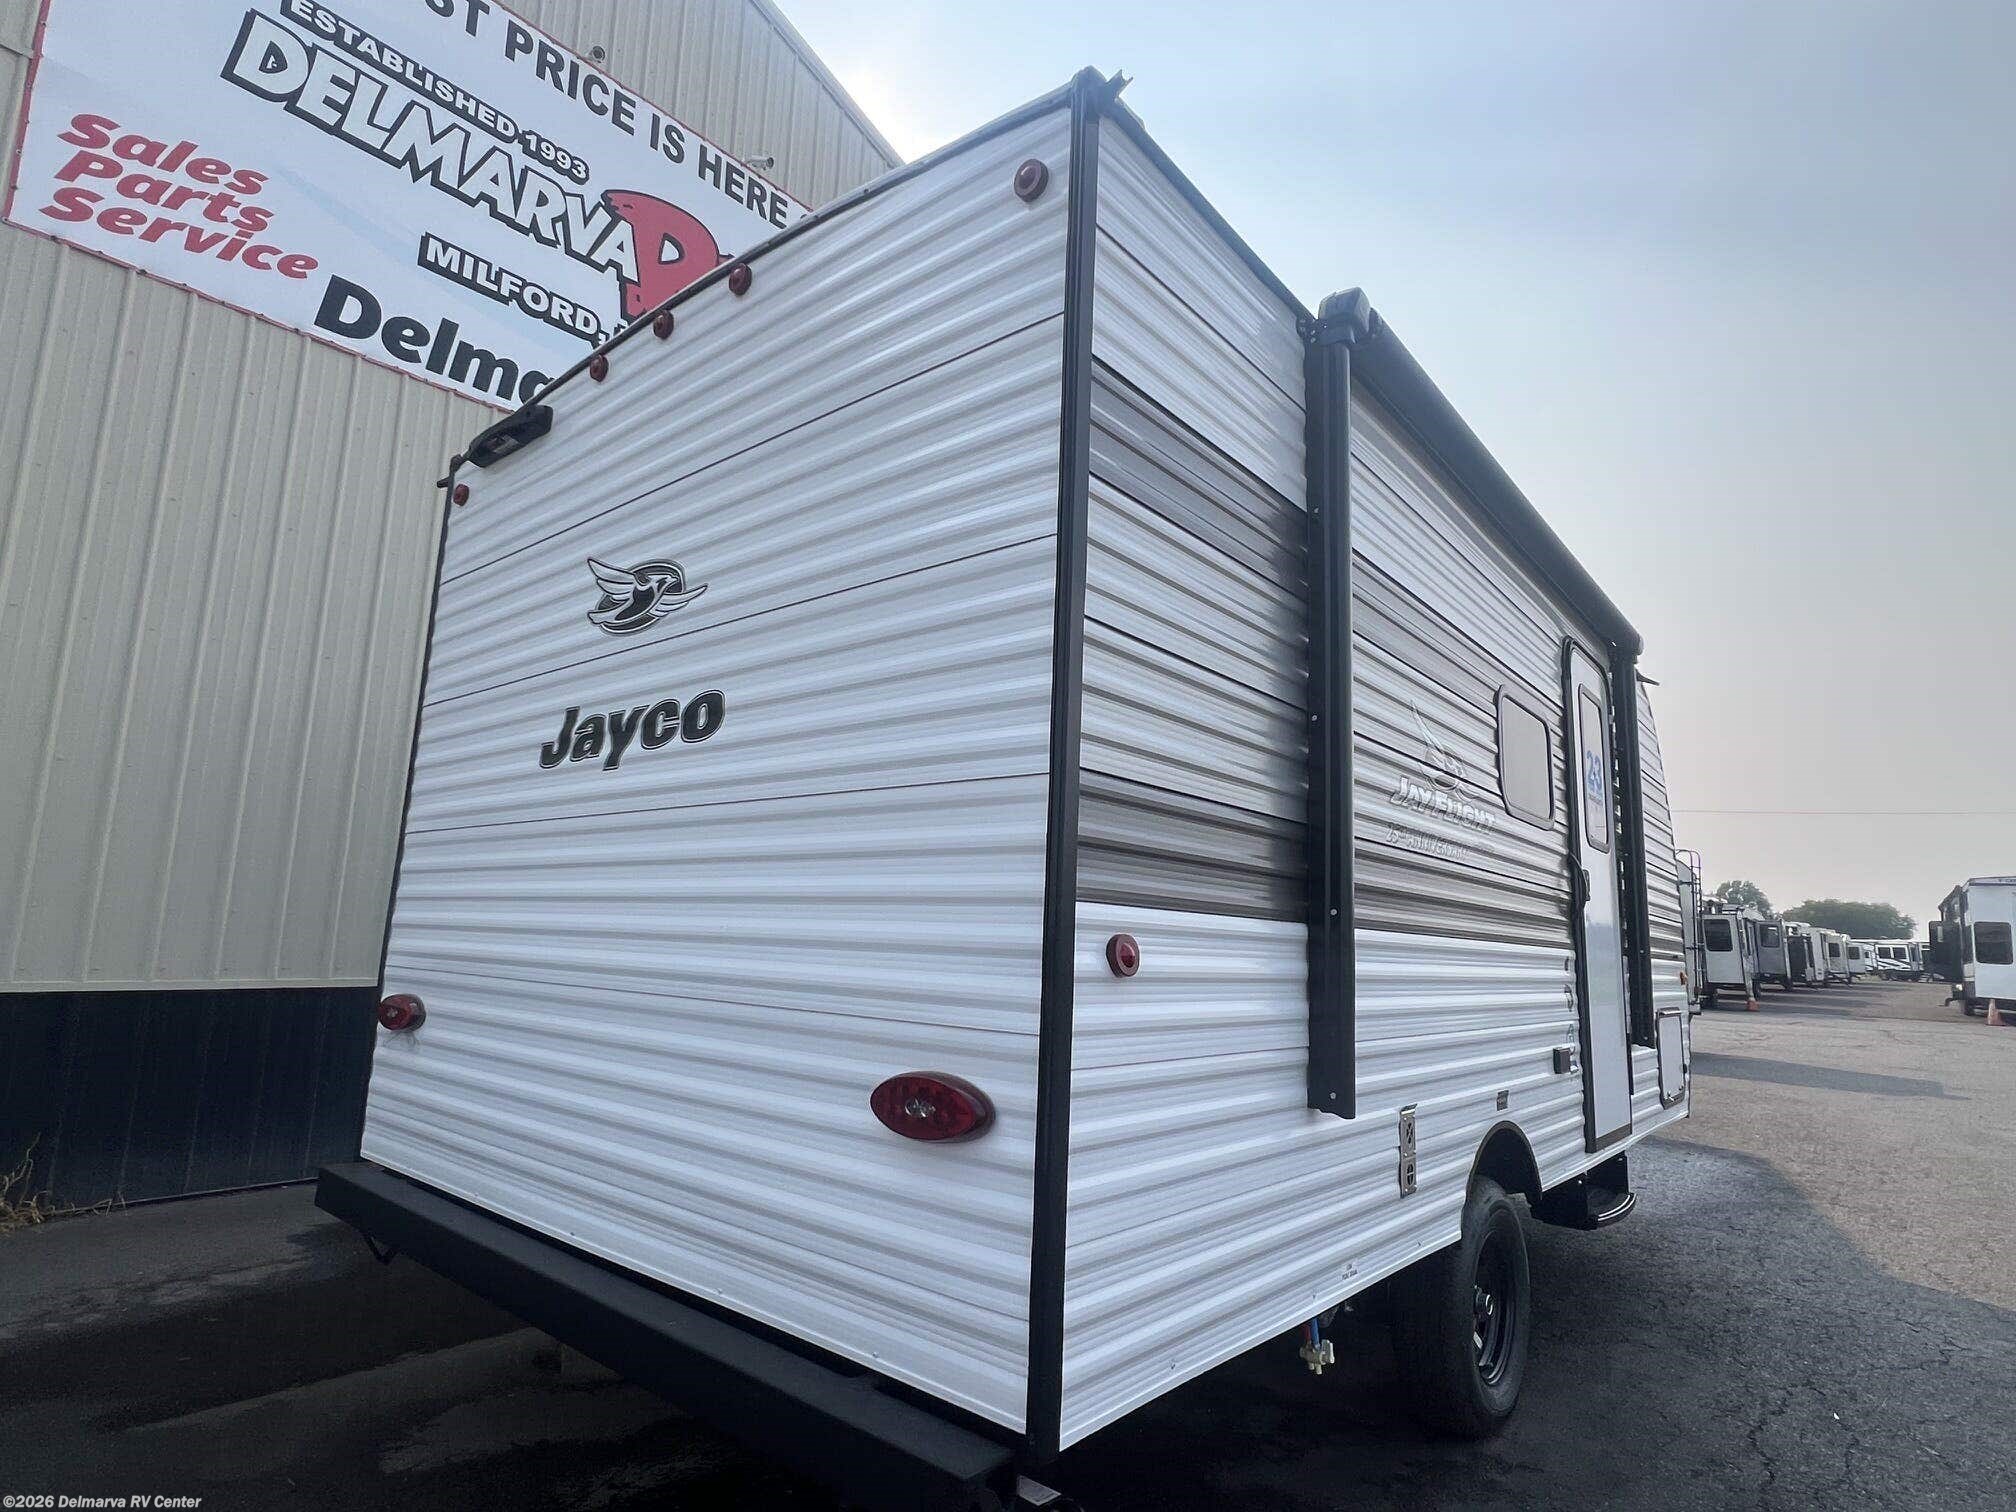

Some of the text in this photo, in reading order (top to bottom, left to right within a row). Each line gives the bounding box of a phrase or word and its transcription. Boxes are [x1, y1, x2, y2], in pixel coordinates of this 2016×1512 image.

[286, 0, 589, 182] ESTABLISHED 1993
[505, 20, 636, 136] PRICE
[649, 113, 685, 164] IS
[698, 144, 788, 229] HERE
[54, 150, 274, 233] Parts
[57, 114, 268, 195] Sales
[221, 9, 640, 285] DELMARVA
[38, 187, 319, 279] Service
[539, 689, 725, 771] Jayco
